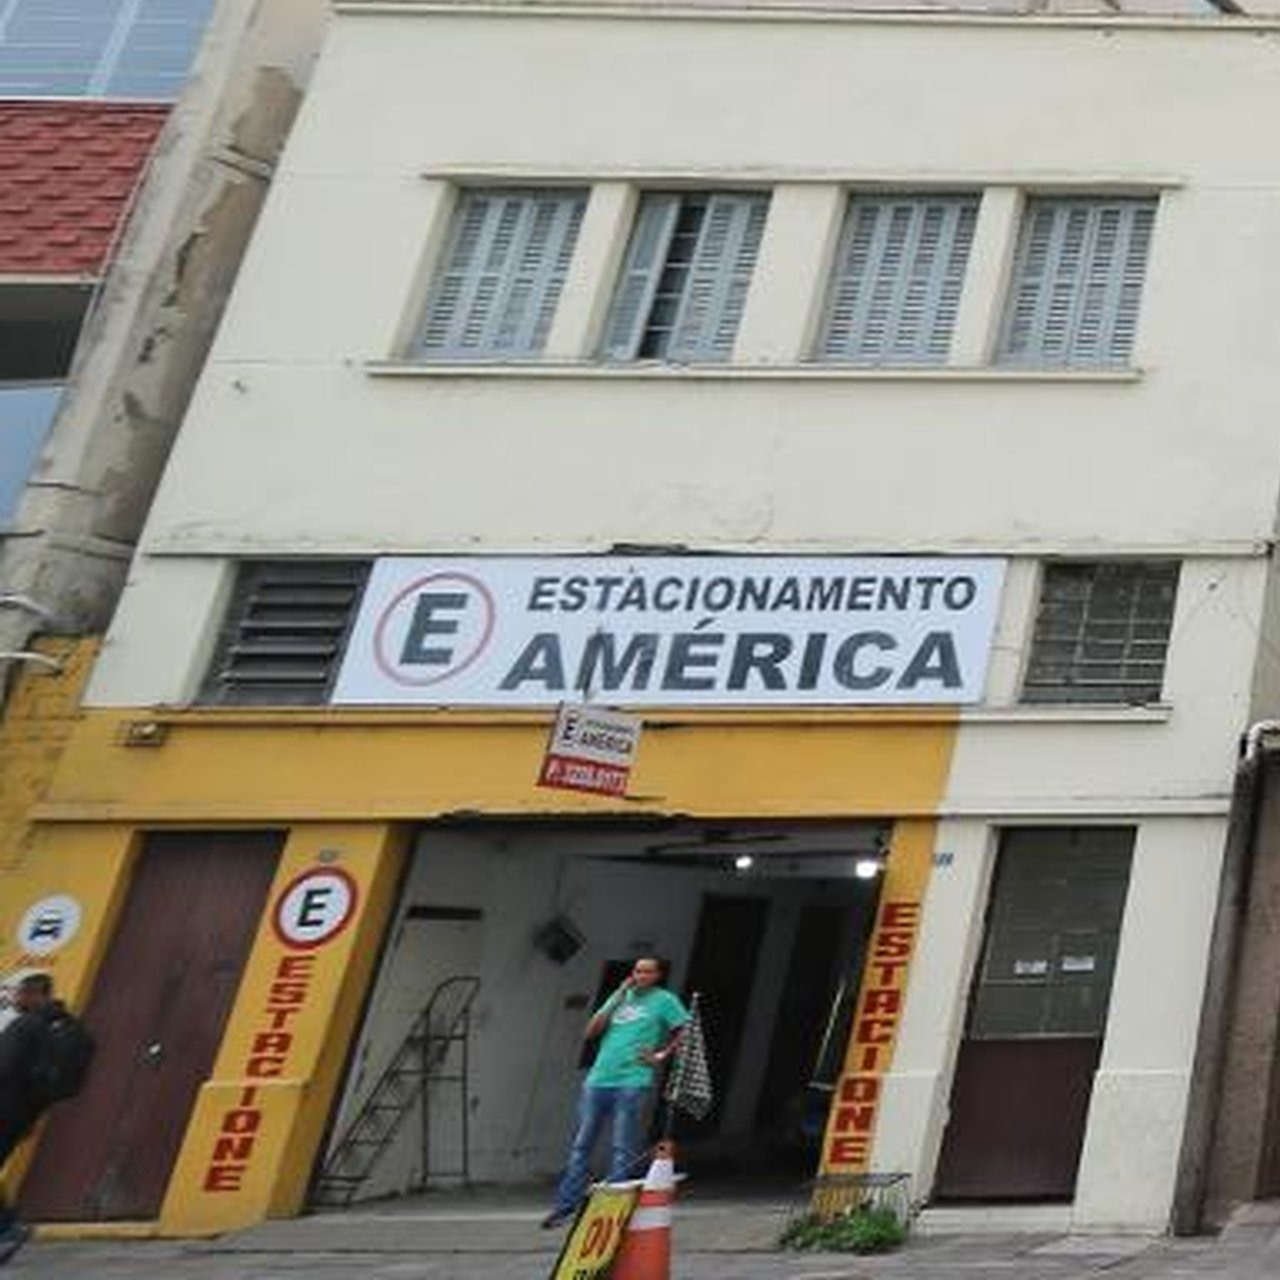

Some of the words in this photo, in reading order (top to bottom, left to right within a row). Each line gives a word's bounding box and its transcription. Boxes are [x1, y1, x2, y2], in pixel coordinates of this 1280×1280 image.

[400, 592, 468, 665] E
[526, 575, 976, 612] ESTACIONAMENTO
[500, 620, 964, 692] AMÉRICA
[297, 888, 333, 927] E
[829, 902, 922, 1162] ESTACIONE
[203, 955, 317, 1192] ESTACIONE
